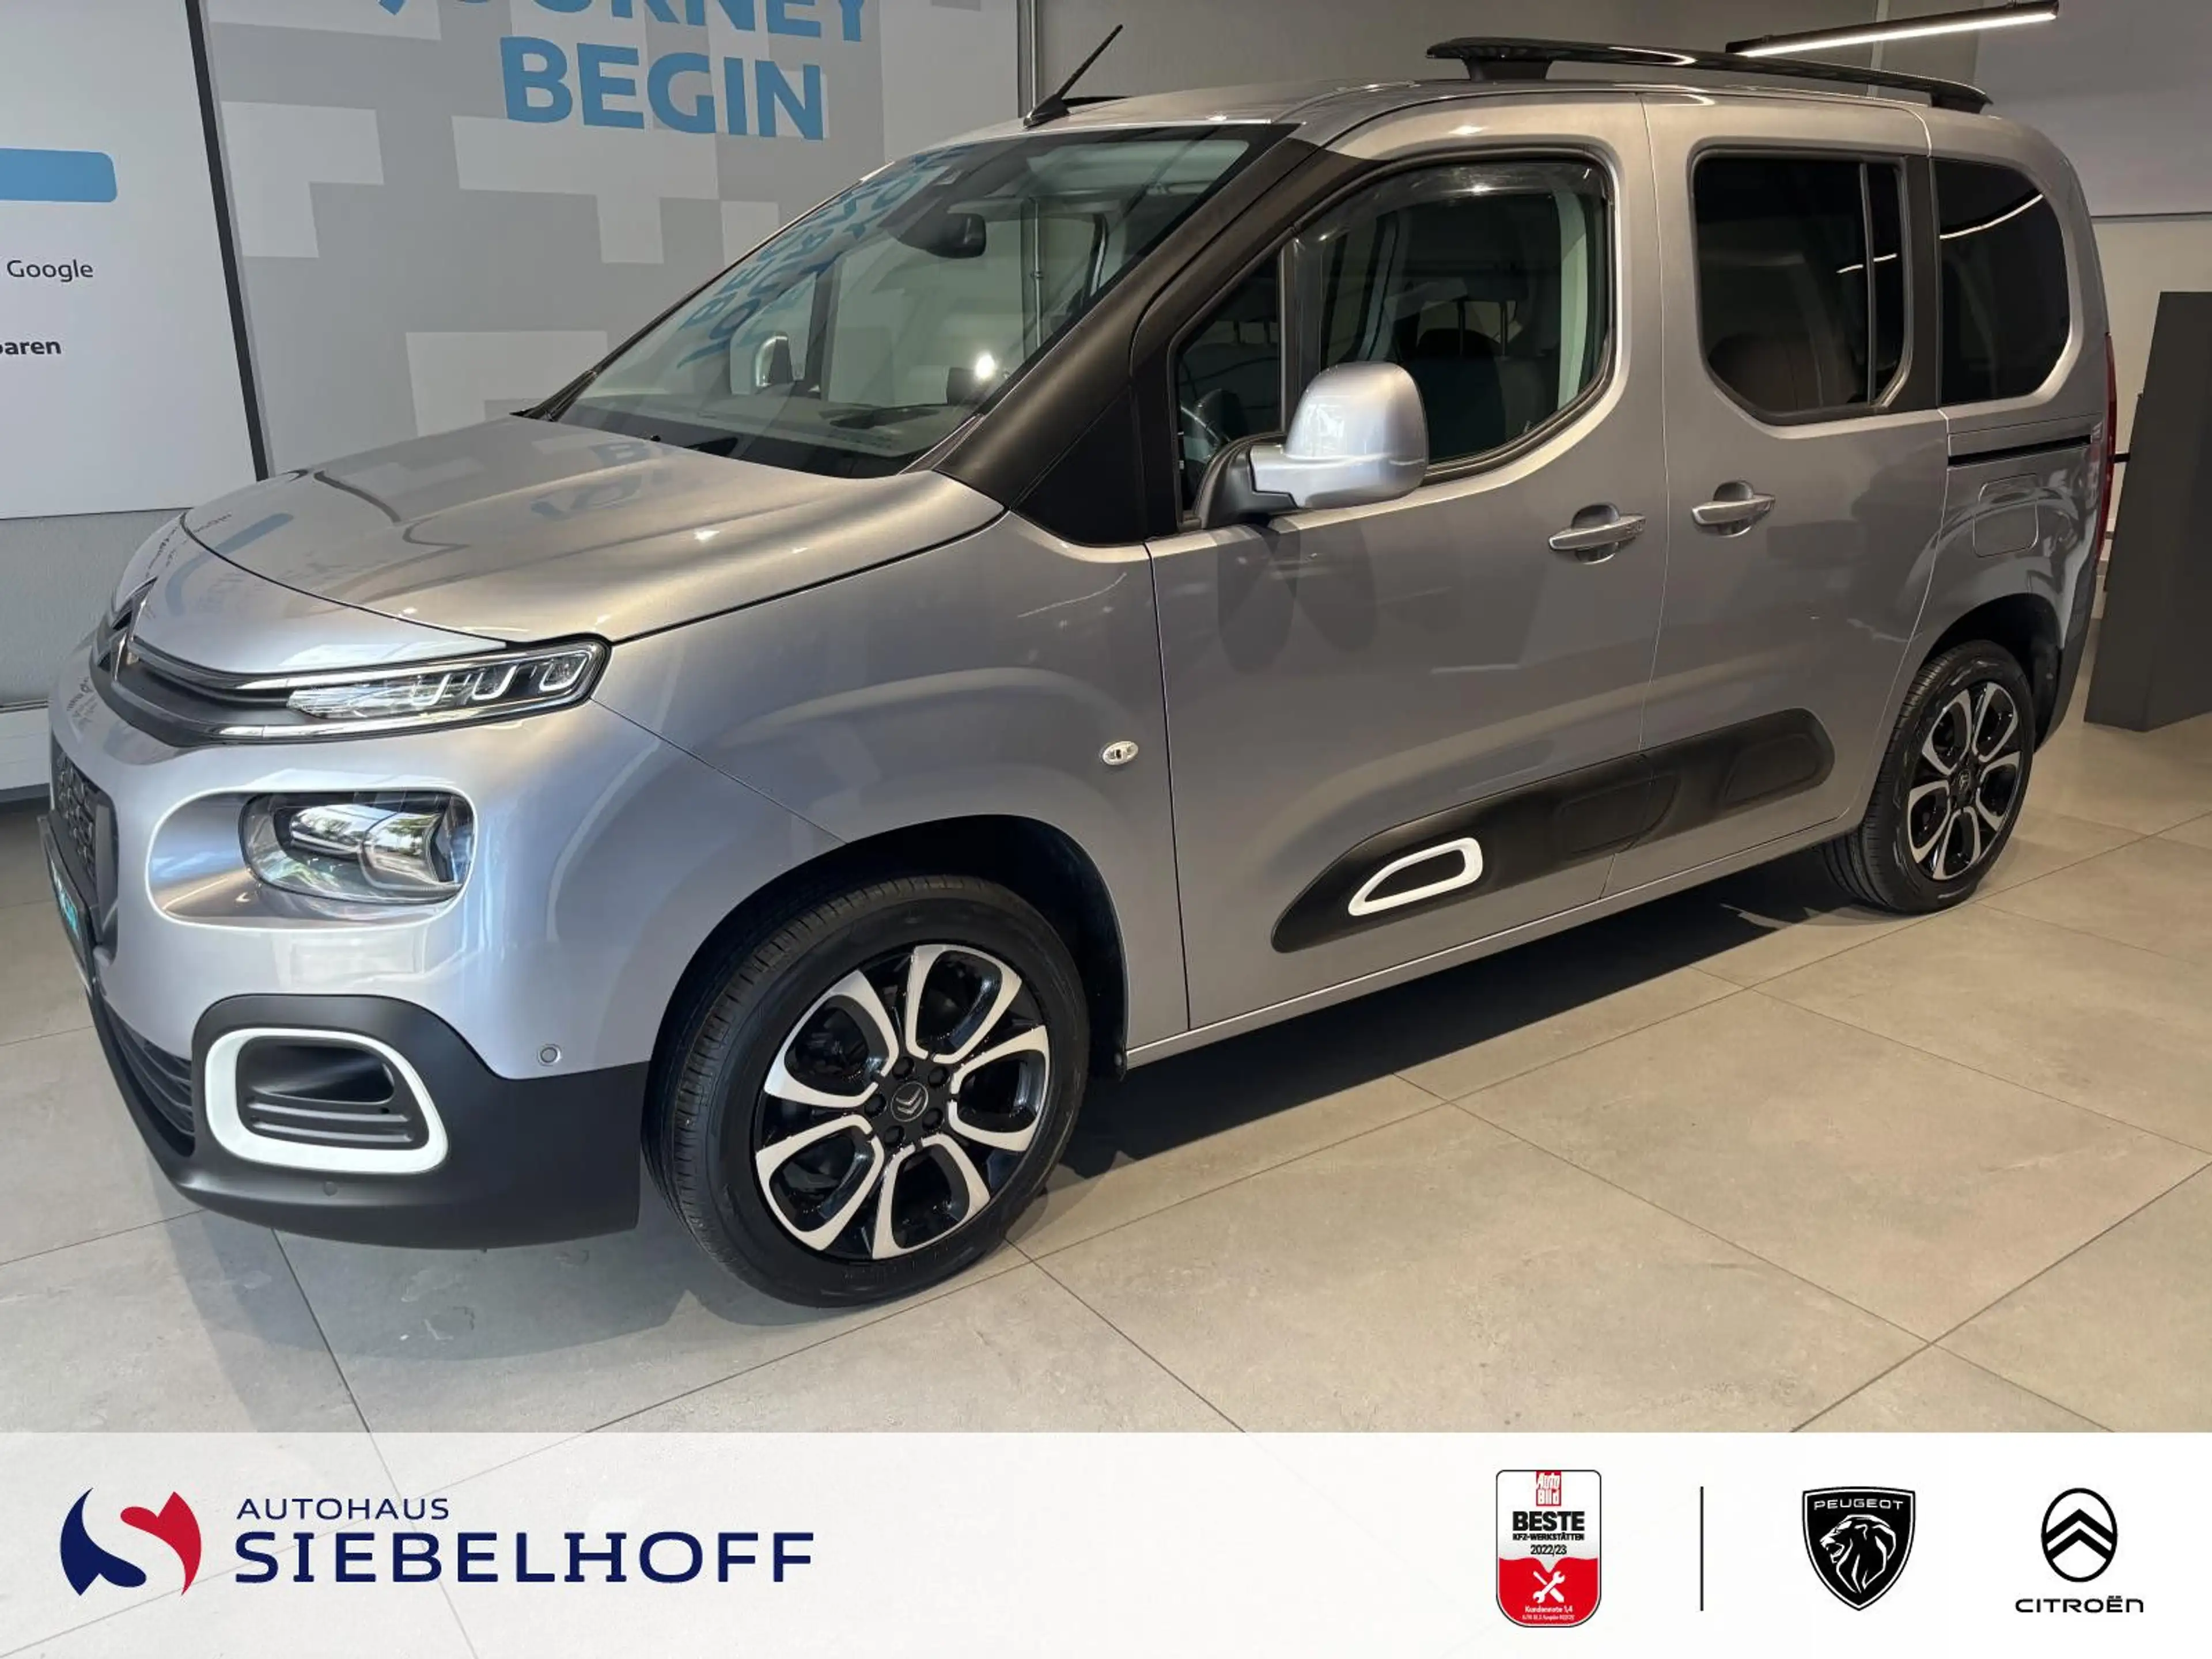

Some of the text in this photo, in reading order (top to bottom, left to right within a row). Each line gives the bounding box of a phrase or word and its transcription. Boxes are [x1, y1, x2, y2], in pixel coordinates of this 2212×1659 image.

[500, 36, 824, 141] BEGIN
[7, 259, 94, 283] Google
[0, 341, 62, 355] aren
